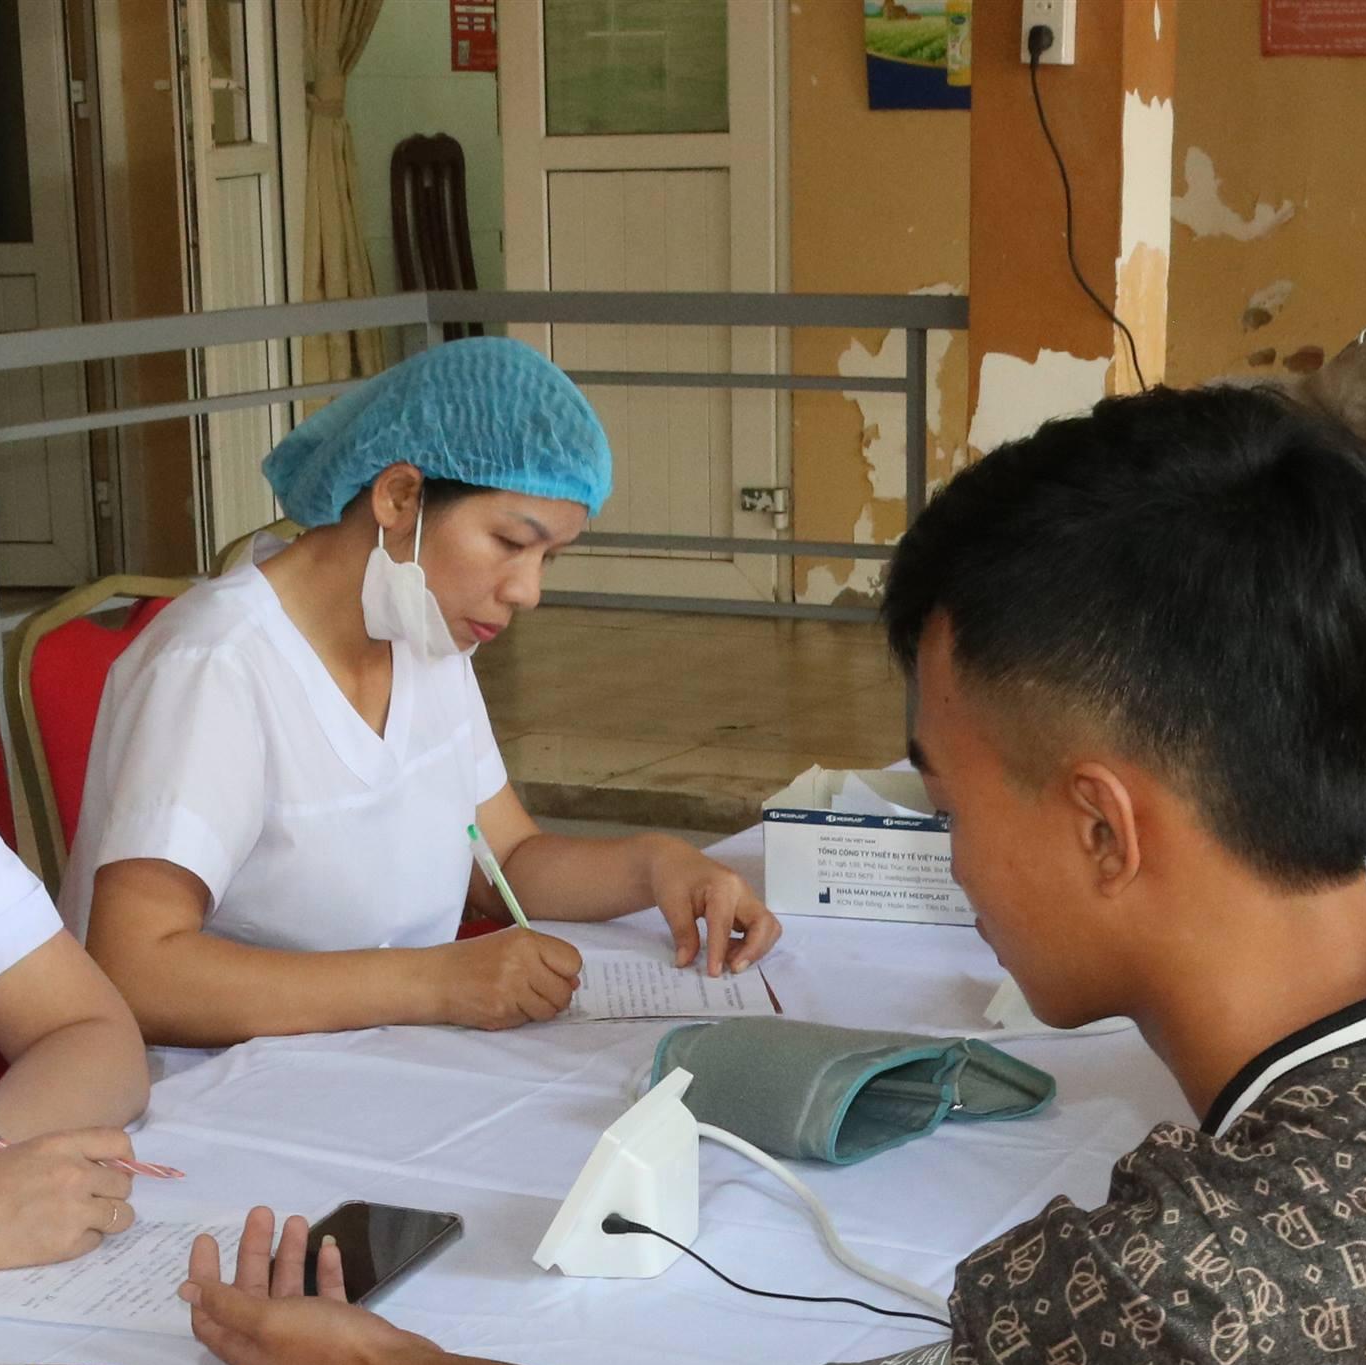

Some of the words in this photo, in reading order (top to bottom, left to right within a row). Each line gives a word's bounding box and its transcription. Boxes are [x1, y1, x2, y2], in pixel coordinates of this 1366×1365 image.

[838, 848, 860, 858] CÔNG
[870, 849, 891, 859] THIẾT
[892, 852, 900, 862] BỊ
[906, 851, 916, 860] TẾ
[916, 853, 933, 863] VIỆT
[836, 887, 852, 895] NHÀ
[853, 888, 869, 896] MÁY
[869, 890, 892, 898] NHỰA
[899, 890, 908, 899] TẾ
[908, 893, 950, 901] MEDIPLAST
